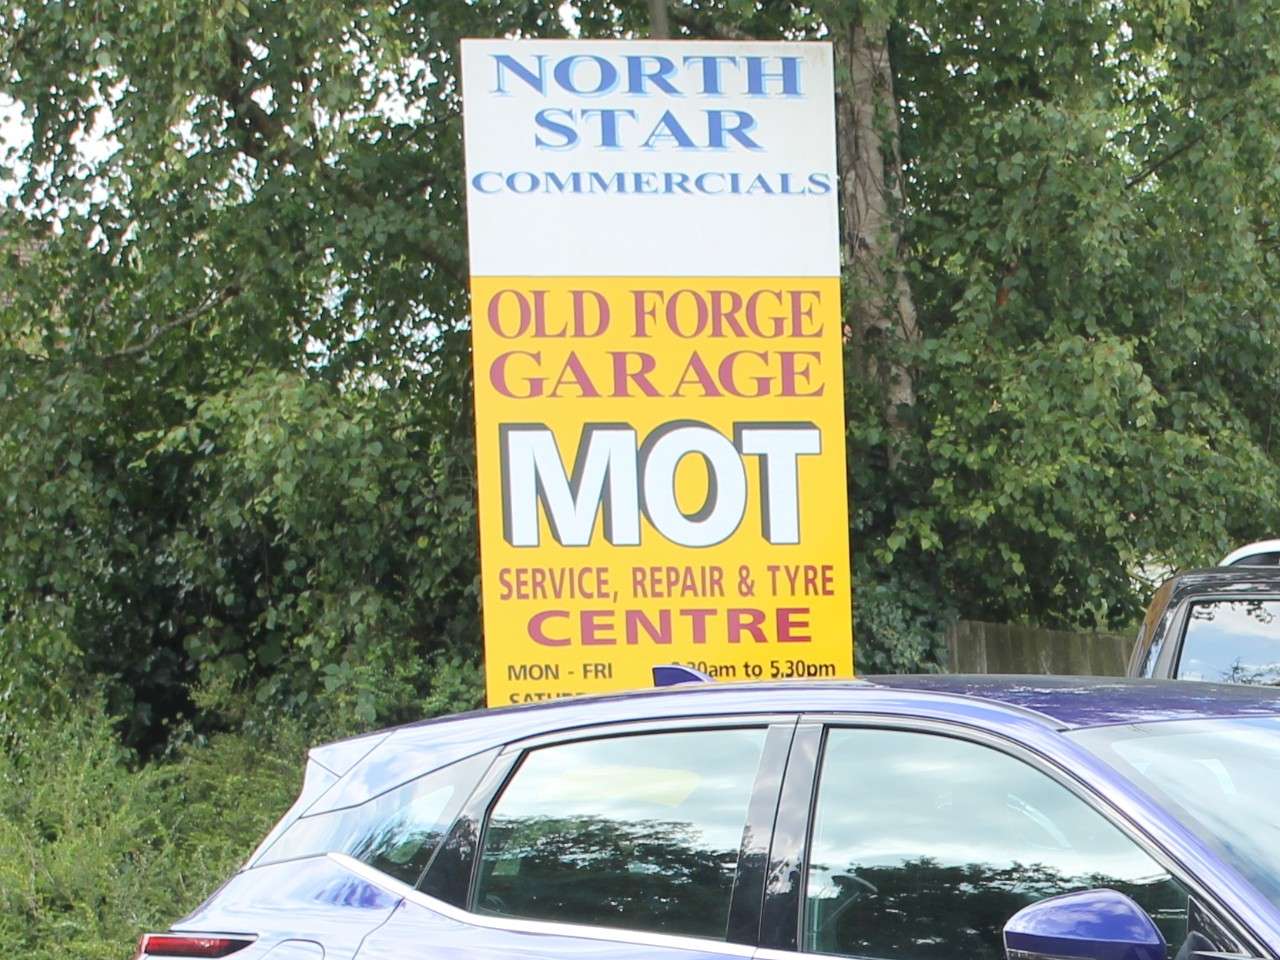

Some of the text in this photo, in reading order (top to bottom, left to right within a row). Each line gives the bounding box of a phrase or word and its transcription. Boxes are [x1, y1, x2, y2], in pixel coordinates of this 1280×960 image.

[488, 53, 806, 98] NORTH
[533, 107, 768, 151] STAR
[471, 171, 832, 196] COMMERCIALS
[487, 289, 824, 339] OLD FORGE
[489, 350, 825, 399] GARAGE
[498, 419, 822, 549] MOT
[499, 564, 835, 603] SERVICE, REPAIR & TYRE
[527, 607, 812, 647] CENTRE
[507, 664, 560, 681] MON
[582, 663, 613, 680] FRI
[743, 662, 762, 678] to
[770, 660, 836, 678] 5.30pm
